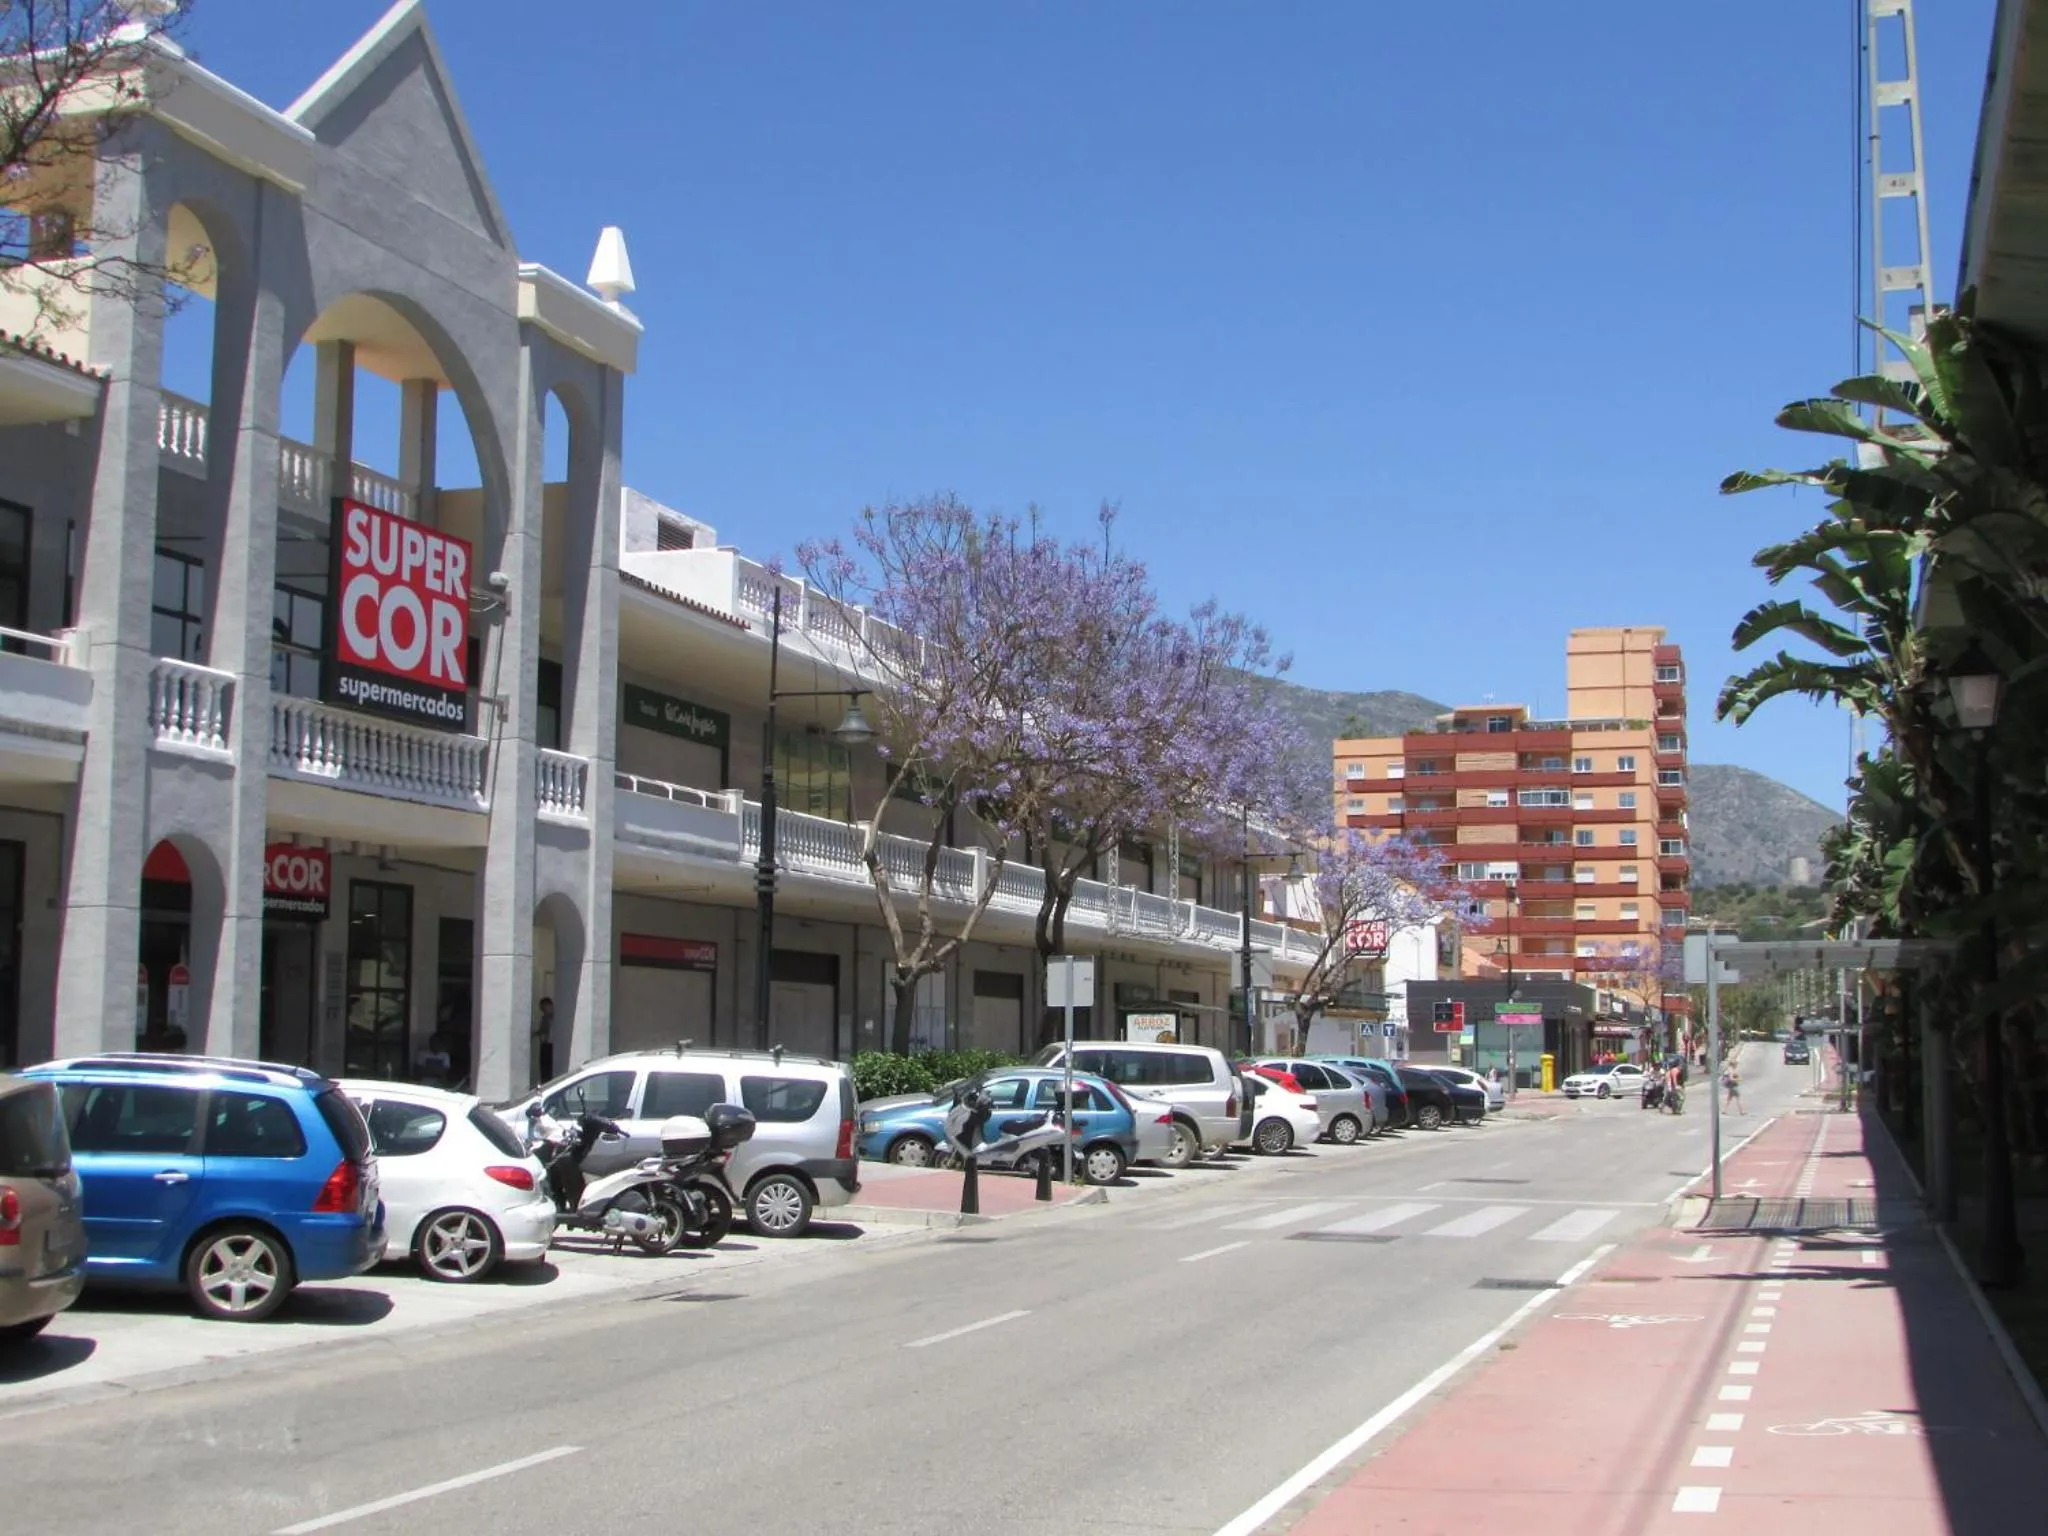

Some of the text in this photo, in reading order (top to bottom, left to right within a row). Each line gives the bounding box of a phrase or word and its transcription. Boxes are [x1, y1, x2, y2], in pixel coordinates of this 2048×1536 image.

[345, 508, 467, 600] SUPER
[342, 573, 464, 683] COR
[339, 676, 464, 721] supermercados
[1346, 931, 1385, 949] COR
